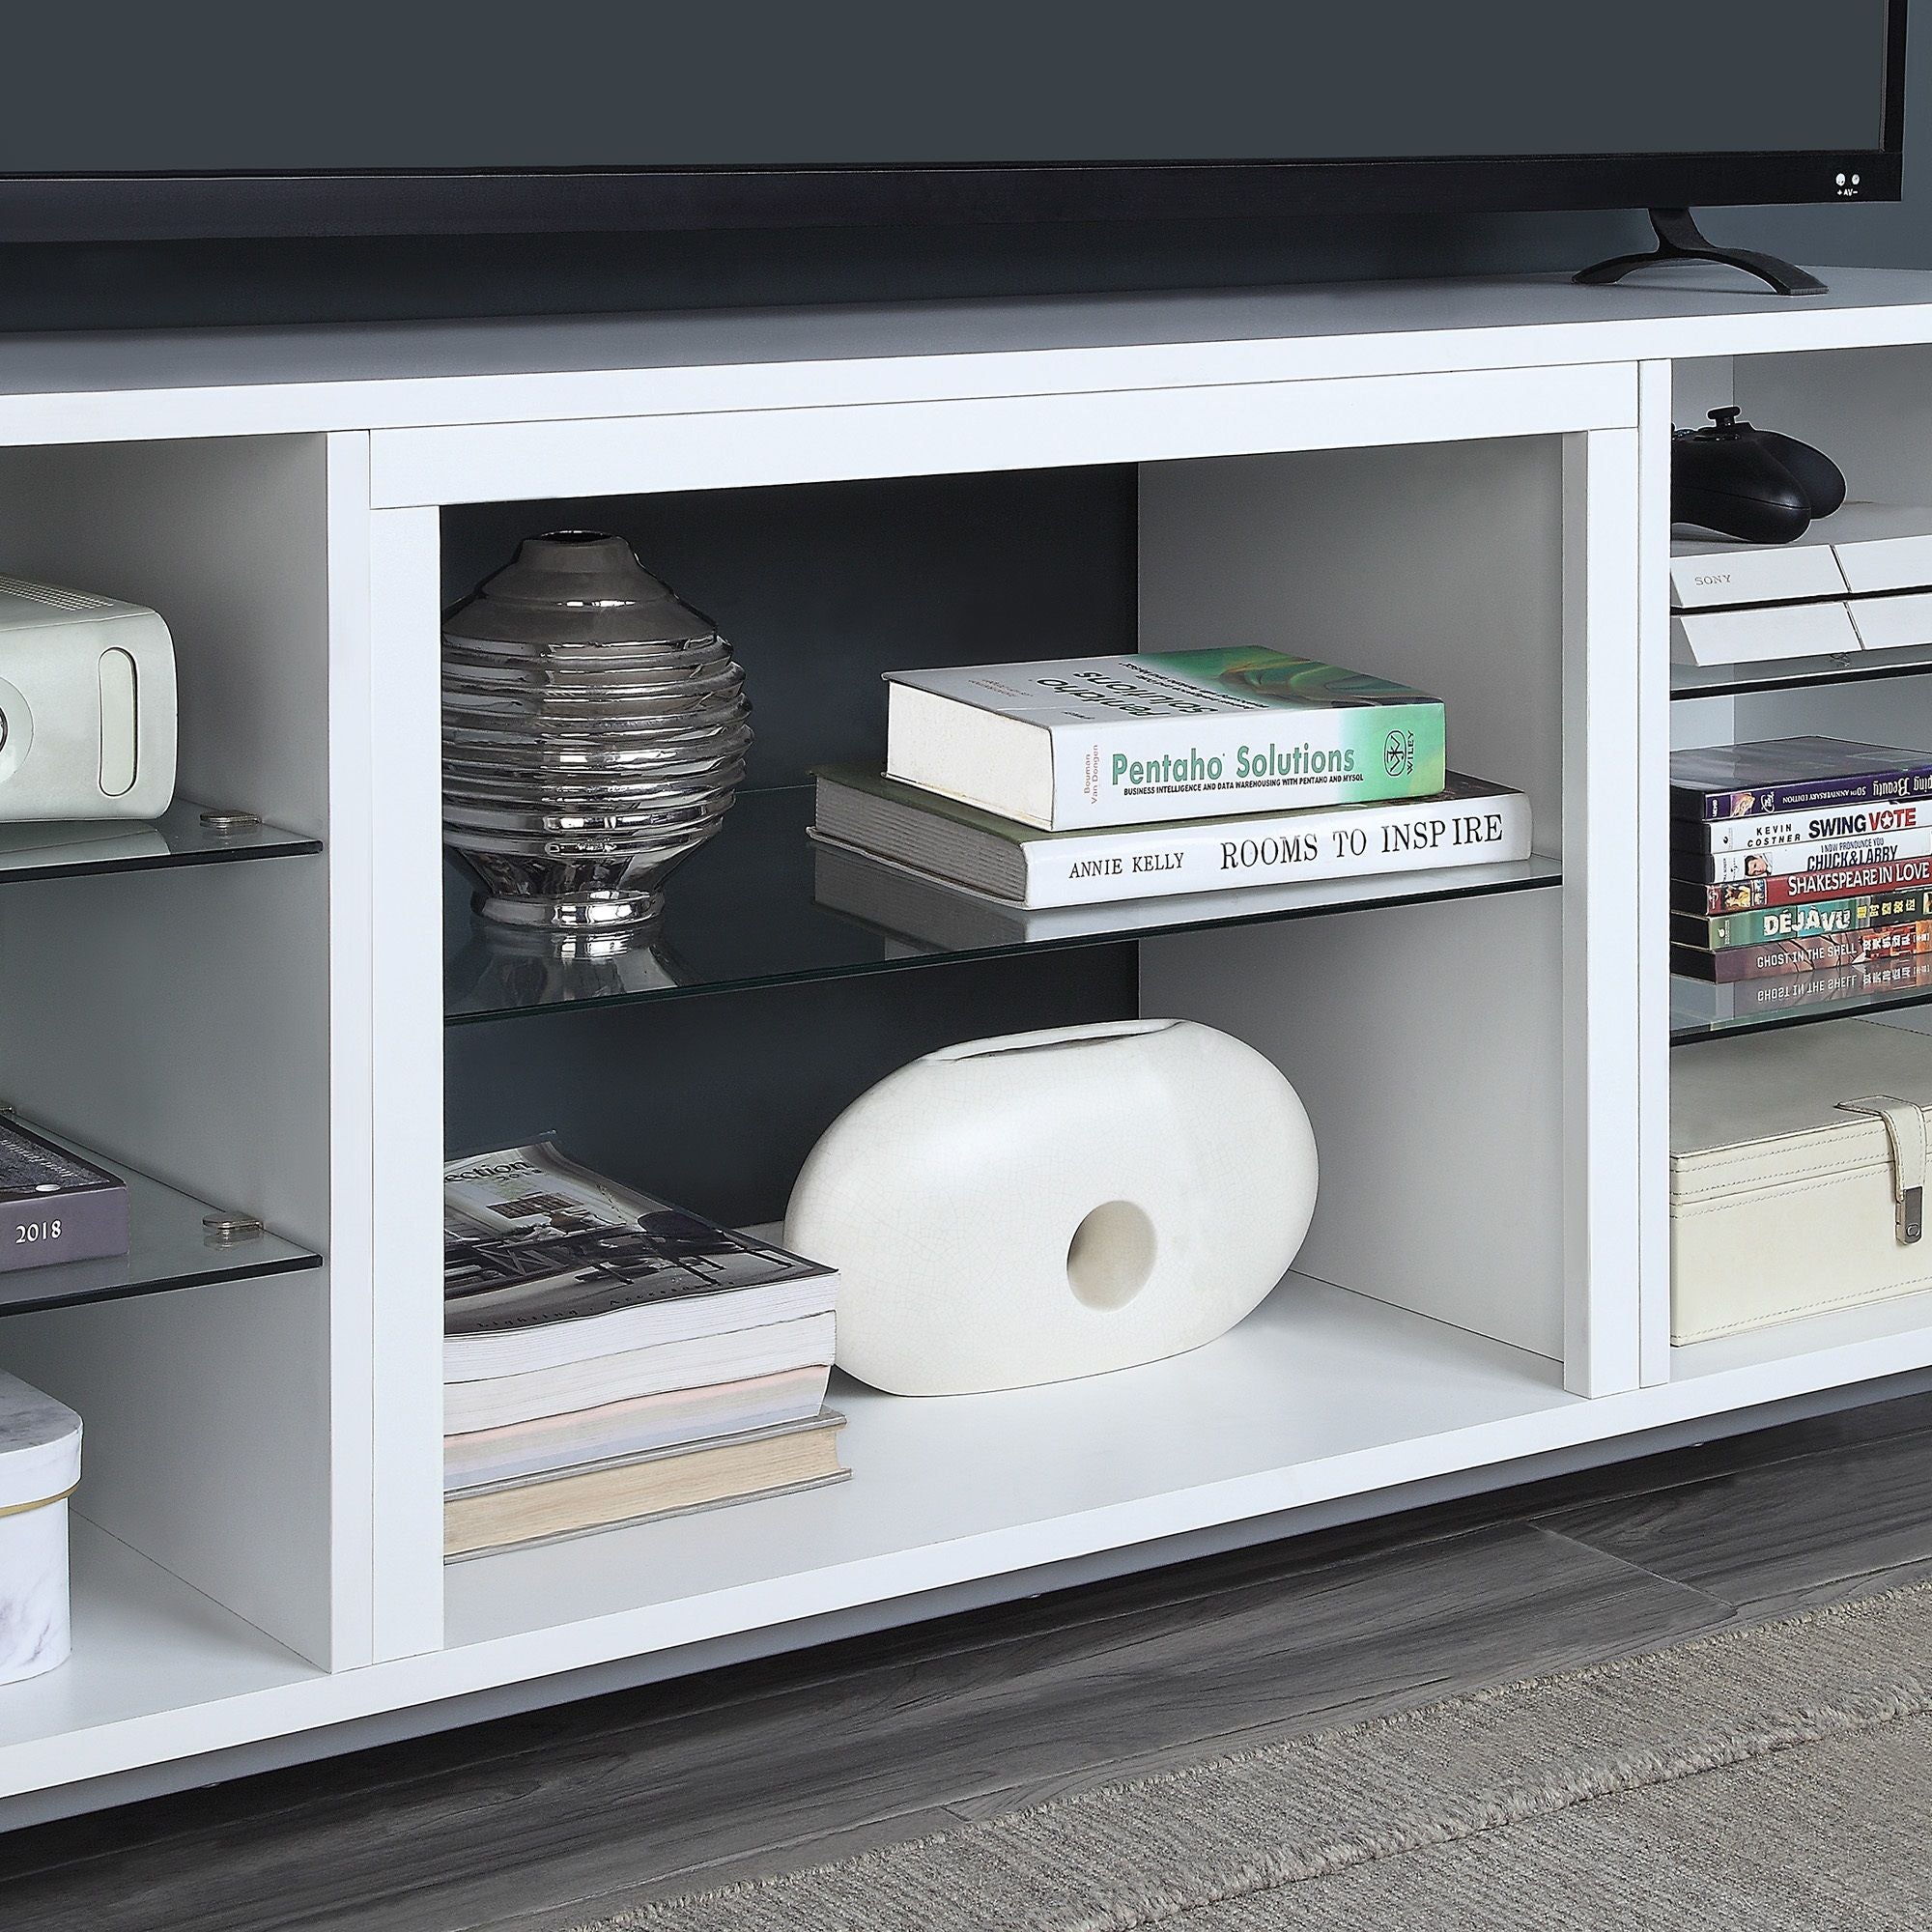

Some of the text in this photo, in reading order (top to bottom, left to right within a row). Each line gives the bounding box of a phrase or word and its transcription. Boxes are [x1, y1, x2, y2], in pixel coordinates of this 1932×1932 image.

[1694, 574, 1732, 586] SONY
[1112, 743, 1355, 785] Pentaho Solutions
[1123, 773, 1364, 796] BUSINESS INTELLIGENCE AND DATA WAREHOUSING WITH PENTAHO AND MYSQL
[1872, 777, 1911, 797] Beauty
[1782, 795, 1808, 804] EDITION
[1756, 823, 1792, 836] KEVIN
[1808, 807, 1917, 838] SWING VOTE
[1220, 813, 1504, 870] ROOMS TO INSPIRE
[1747, 833, 1801, 847] COSTNER
[1825, 842, 1838, 852] NOW
[1838, 838, 1872, 850] PRONOUNCE
[1068, 851, 1184, 880] ANNIE KELLY
[1788, 862, 1930, 896] SHAKESPEARE IN LOVE
[1757, 952, 1791, 968] GHOST
[1792, 951, 1804, 963] IN
[1807, 947, 1825, 960] THE
[1827, 943, 1858, 957] SHELL
[15, 1219, 62, 1244] 2018
